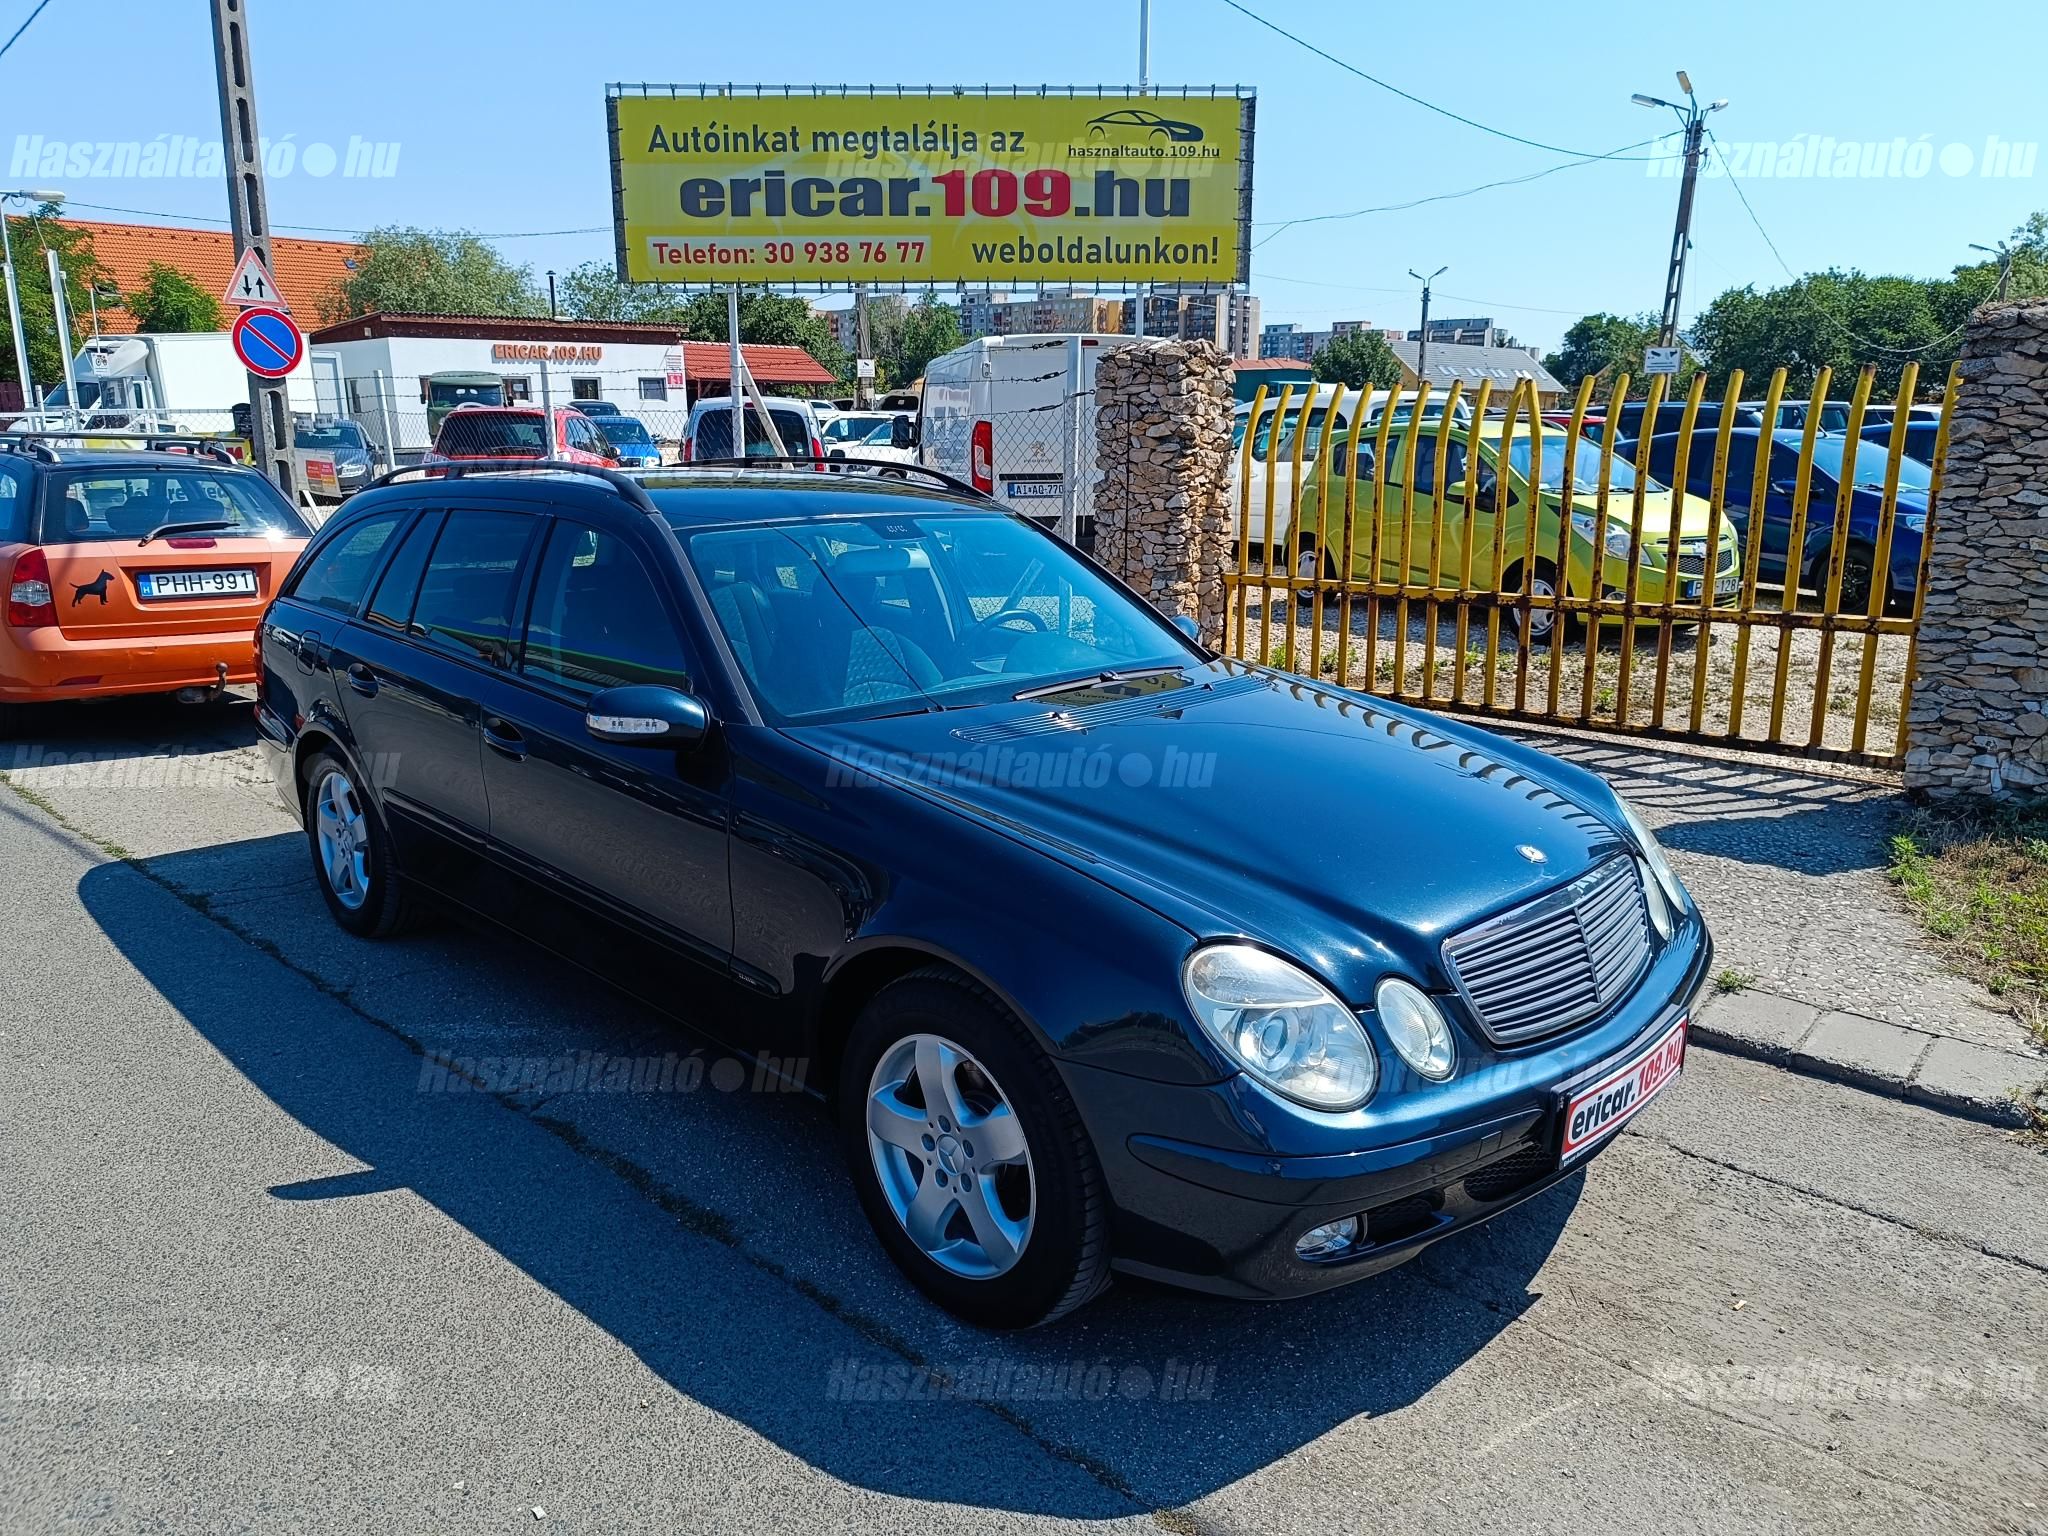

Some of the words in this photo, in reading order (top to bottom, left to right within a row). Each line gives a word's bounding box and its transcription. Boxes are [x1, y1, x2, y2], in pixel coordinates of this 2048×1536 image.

[648, 121, 799, 153] Autóinkat
[812, 120, 978, 159] megtalálja
[990, 131, 1025, 153] az
[1068, 144, 1221, 158] hasznaltauto.109.hu
[679, 169, 1190, 217] ericar.109.hu
[652, 242, 755, 265] Telefon:
[764, 242, 795, 264] 30
[804, 242, 850, 264] 938
[859, 242, 887, 264] 76
[896, 242, 925, 264] 77
[972, 236, 1219, 265] weboldalunkon!
[492, 344, 602, 362] ERICAR.109.HU
[155, 572, 249, 593] PHH-991
[1695, 578, 1737, 595] P-128
[1570, 1036, 1682, 1141] ericar.109.hu
